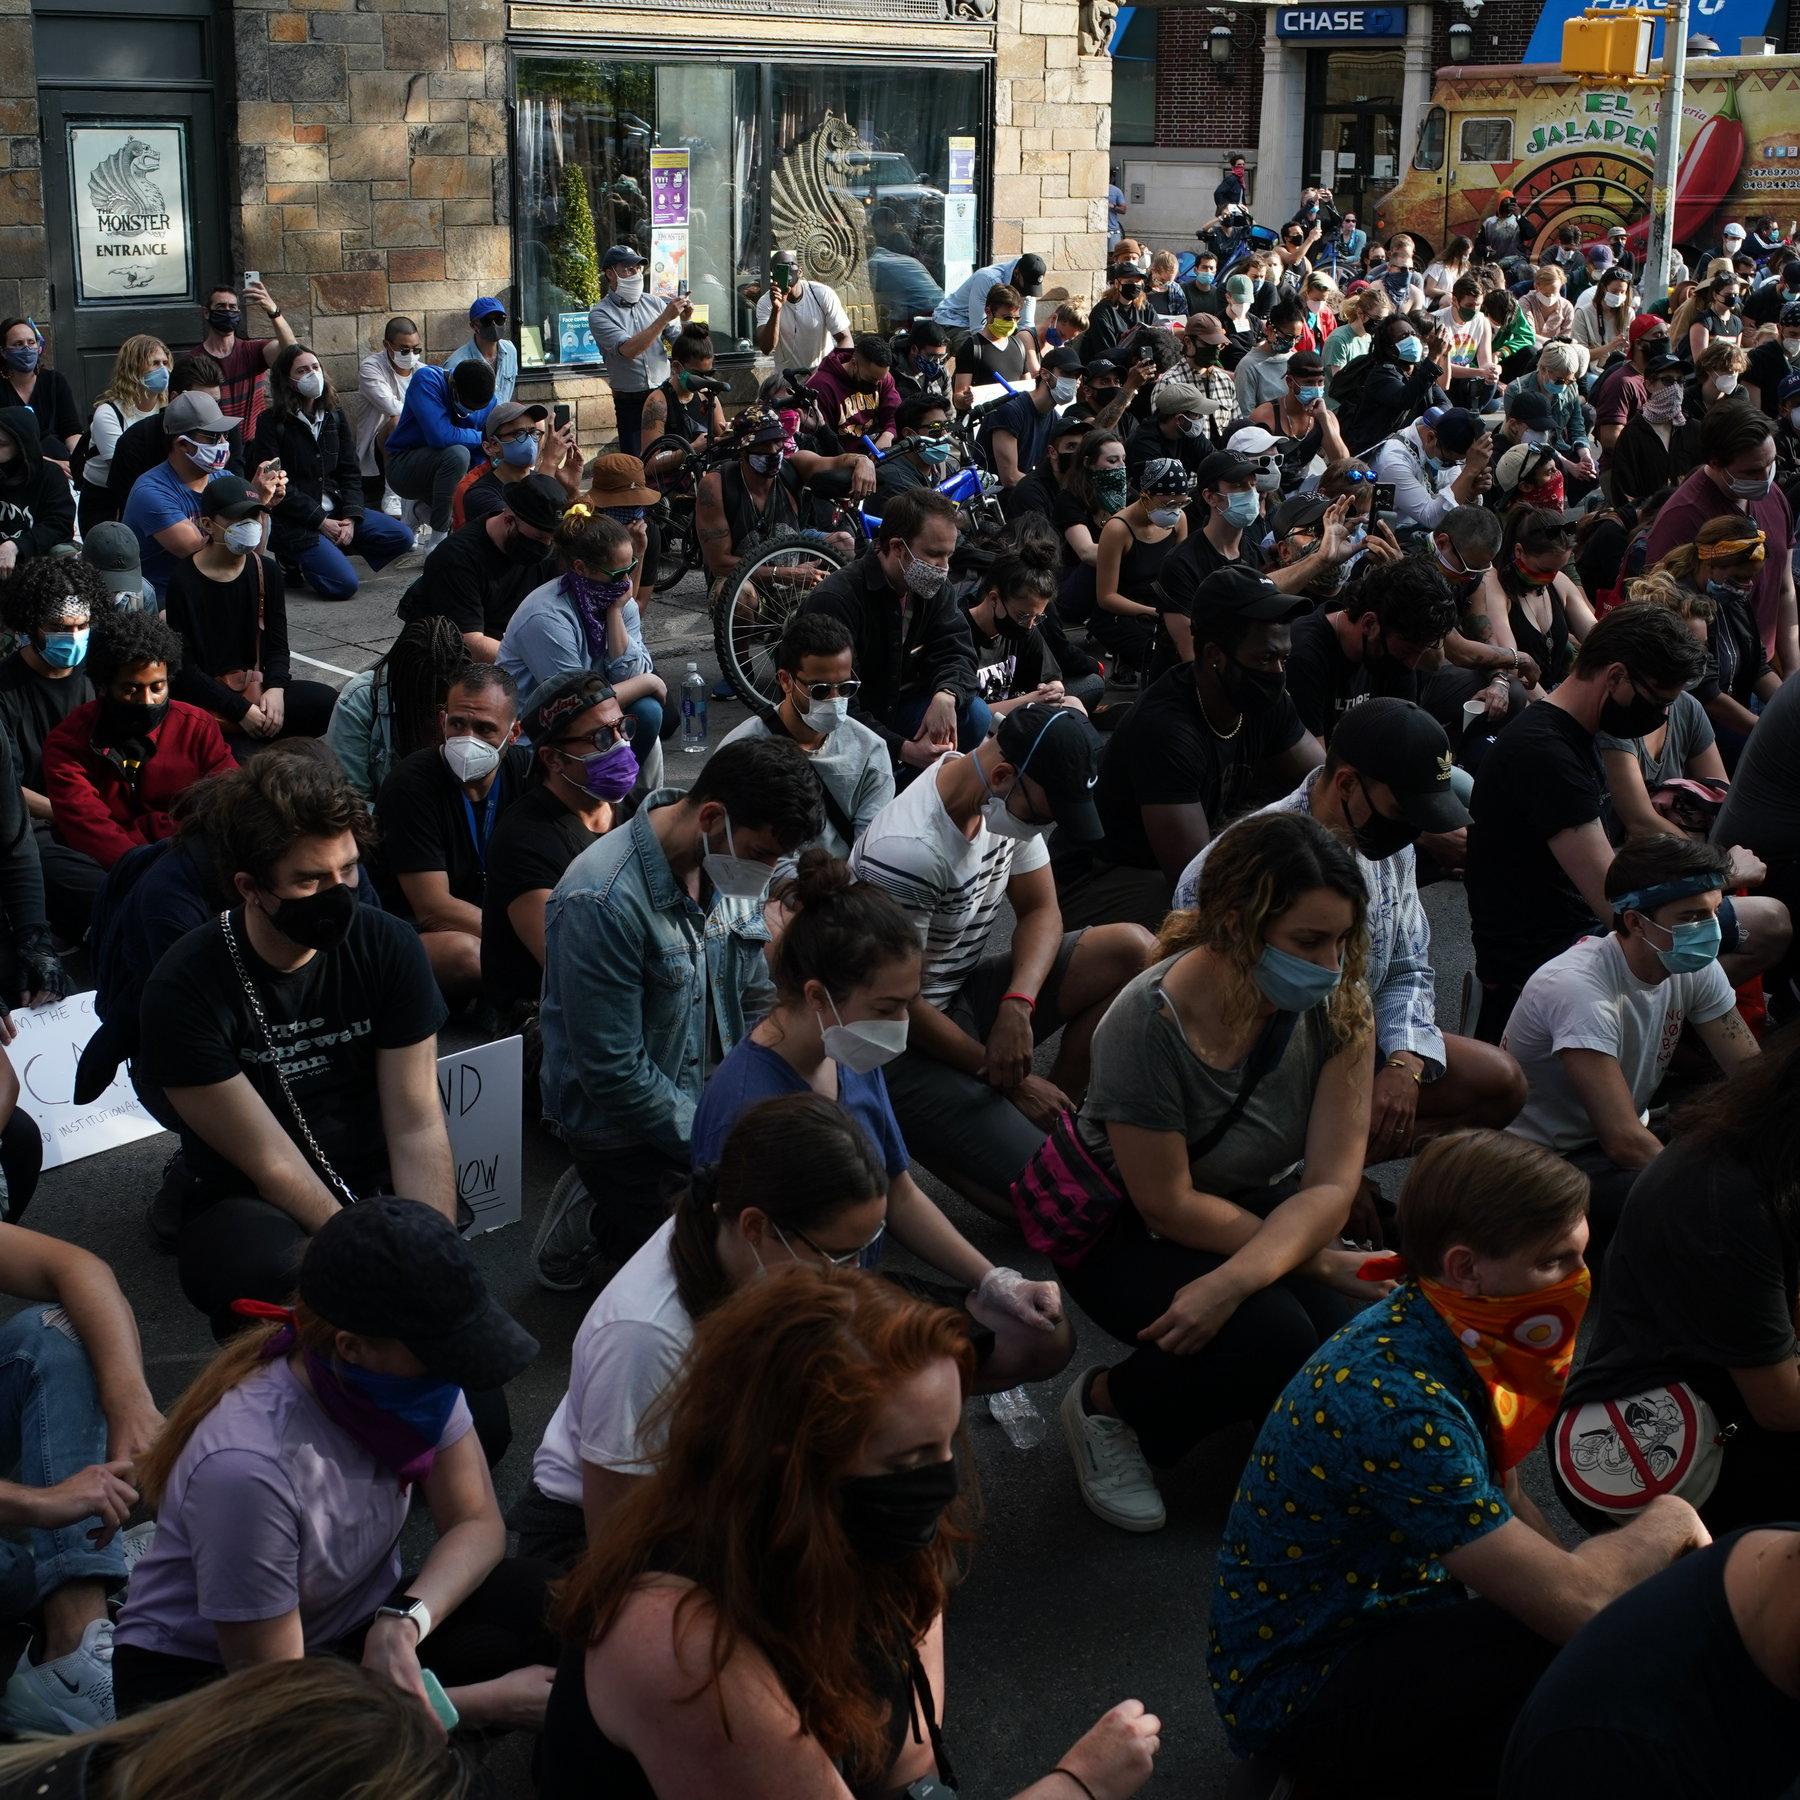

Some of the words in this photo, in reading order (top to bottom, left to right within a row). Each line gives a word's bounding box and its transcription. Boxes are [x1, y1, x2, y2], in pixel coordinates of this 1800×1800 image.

[1283, 11, 1363, 31] CHASE
[1584, 93, 1635, 117] EL
[98, 213, 171, 232] MONSTER
[96, 243, 168, 258] ENTRANCE
[33, 1004, 71, 1026] THE
[271, 1017, 326, 1039] The
[436, 1063, 482, 1118] ND
[58, 1101, 140, 1138] INSTITUTIONAL
